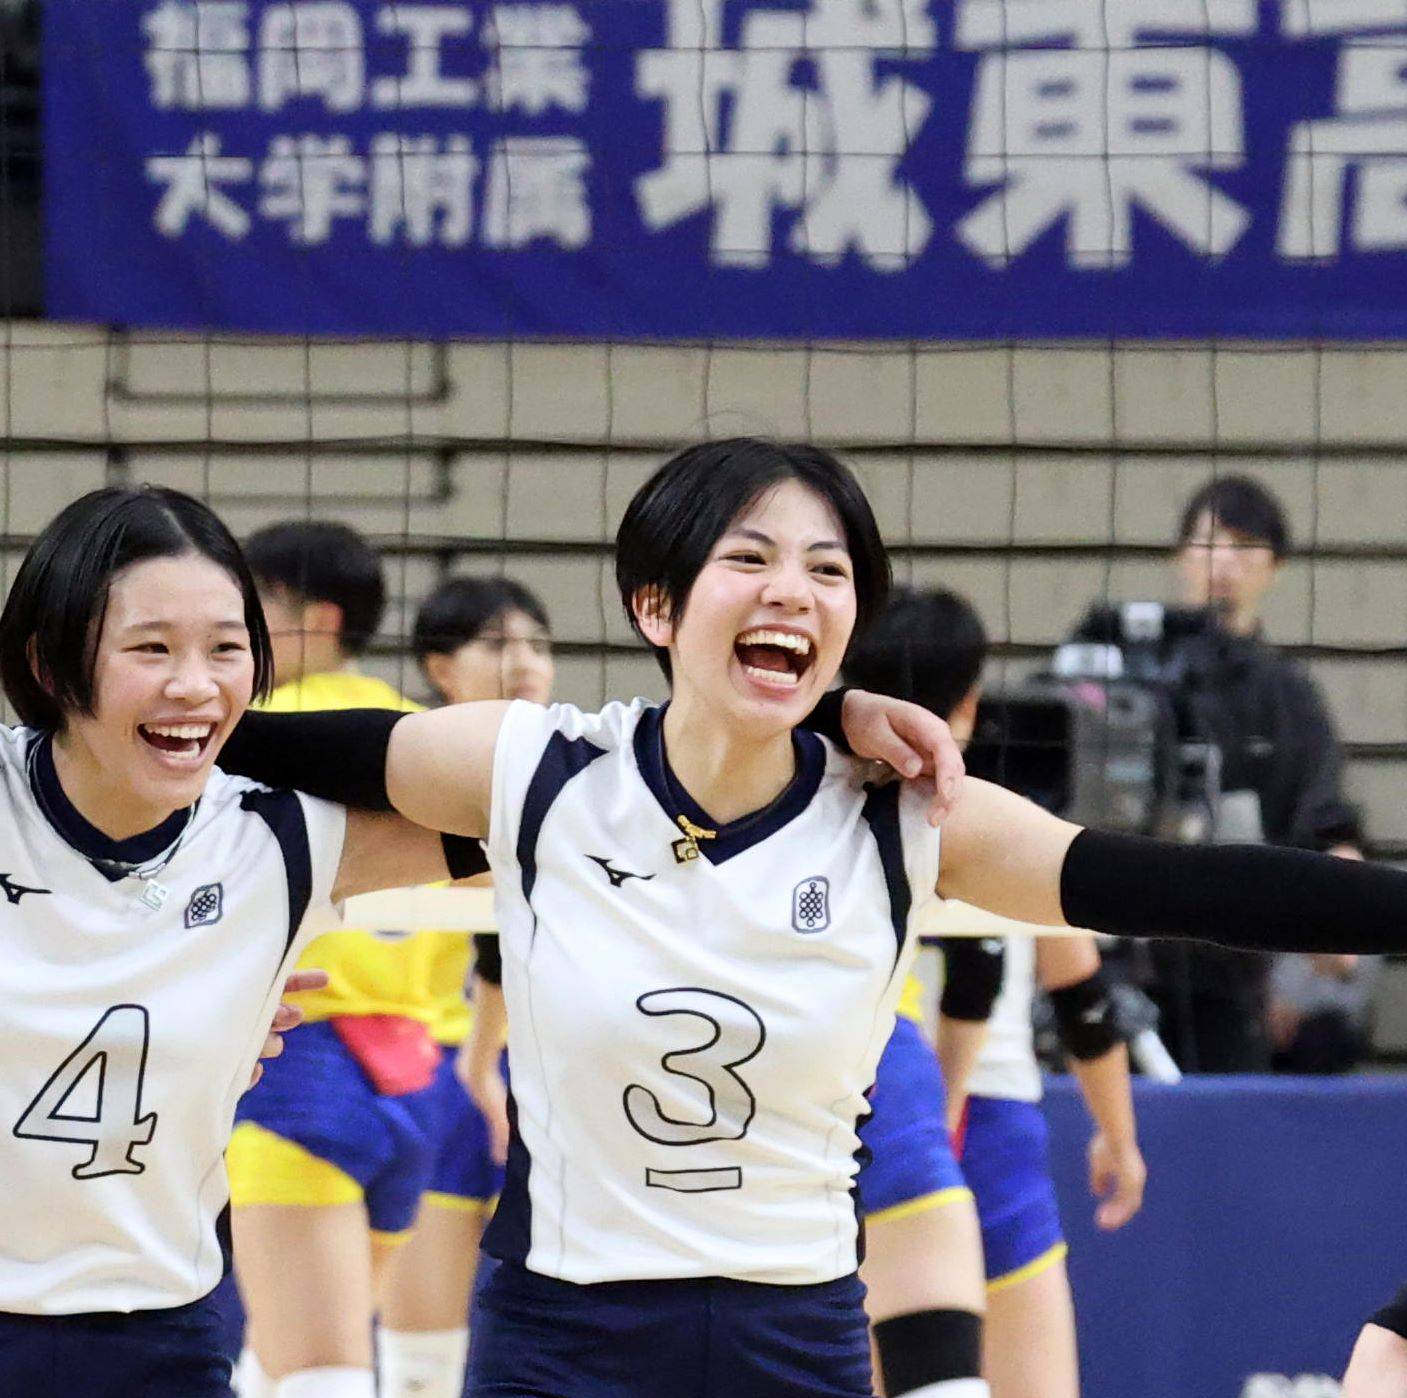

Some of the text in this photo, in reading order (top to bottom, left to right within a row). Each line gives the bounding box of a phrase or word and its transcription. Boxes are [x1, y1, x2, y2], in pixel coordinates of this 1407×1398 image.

[141, 0, 588, 112] 福岡工業
[144, 132, 591, 249] 大学附属
[11, 1002, 159, 1181] 4
[621, 985, 768, 1148] 3
